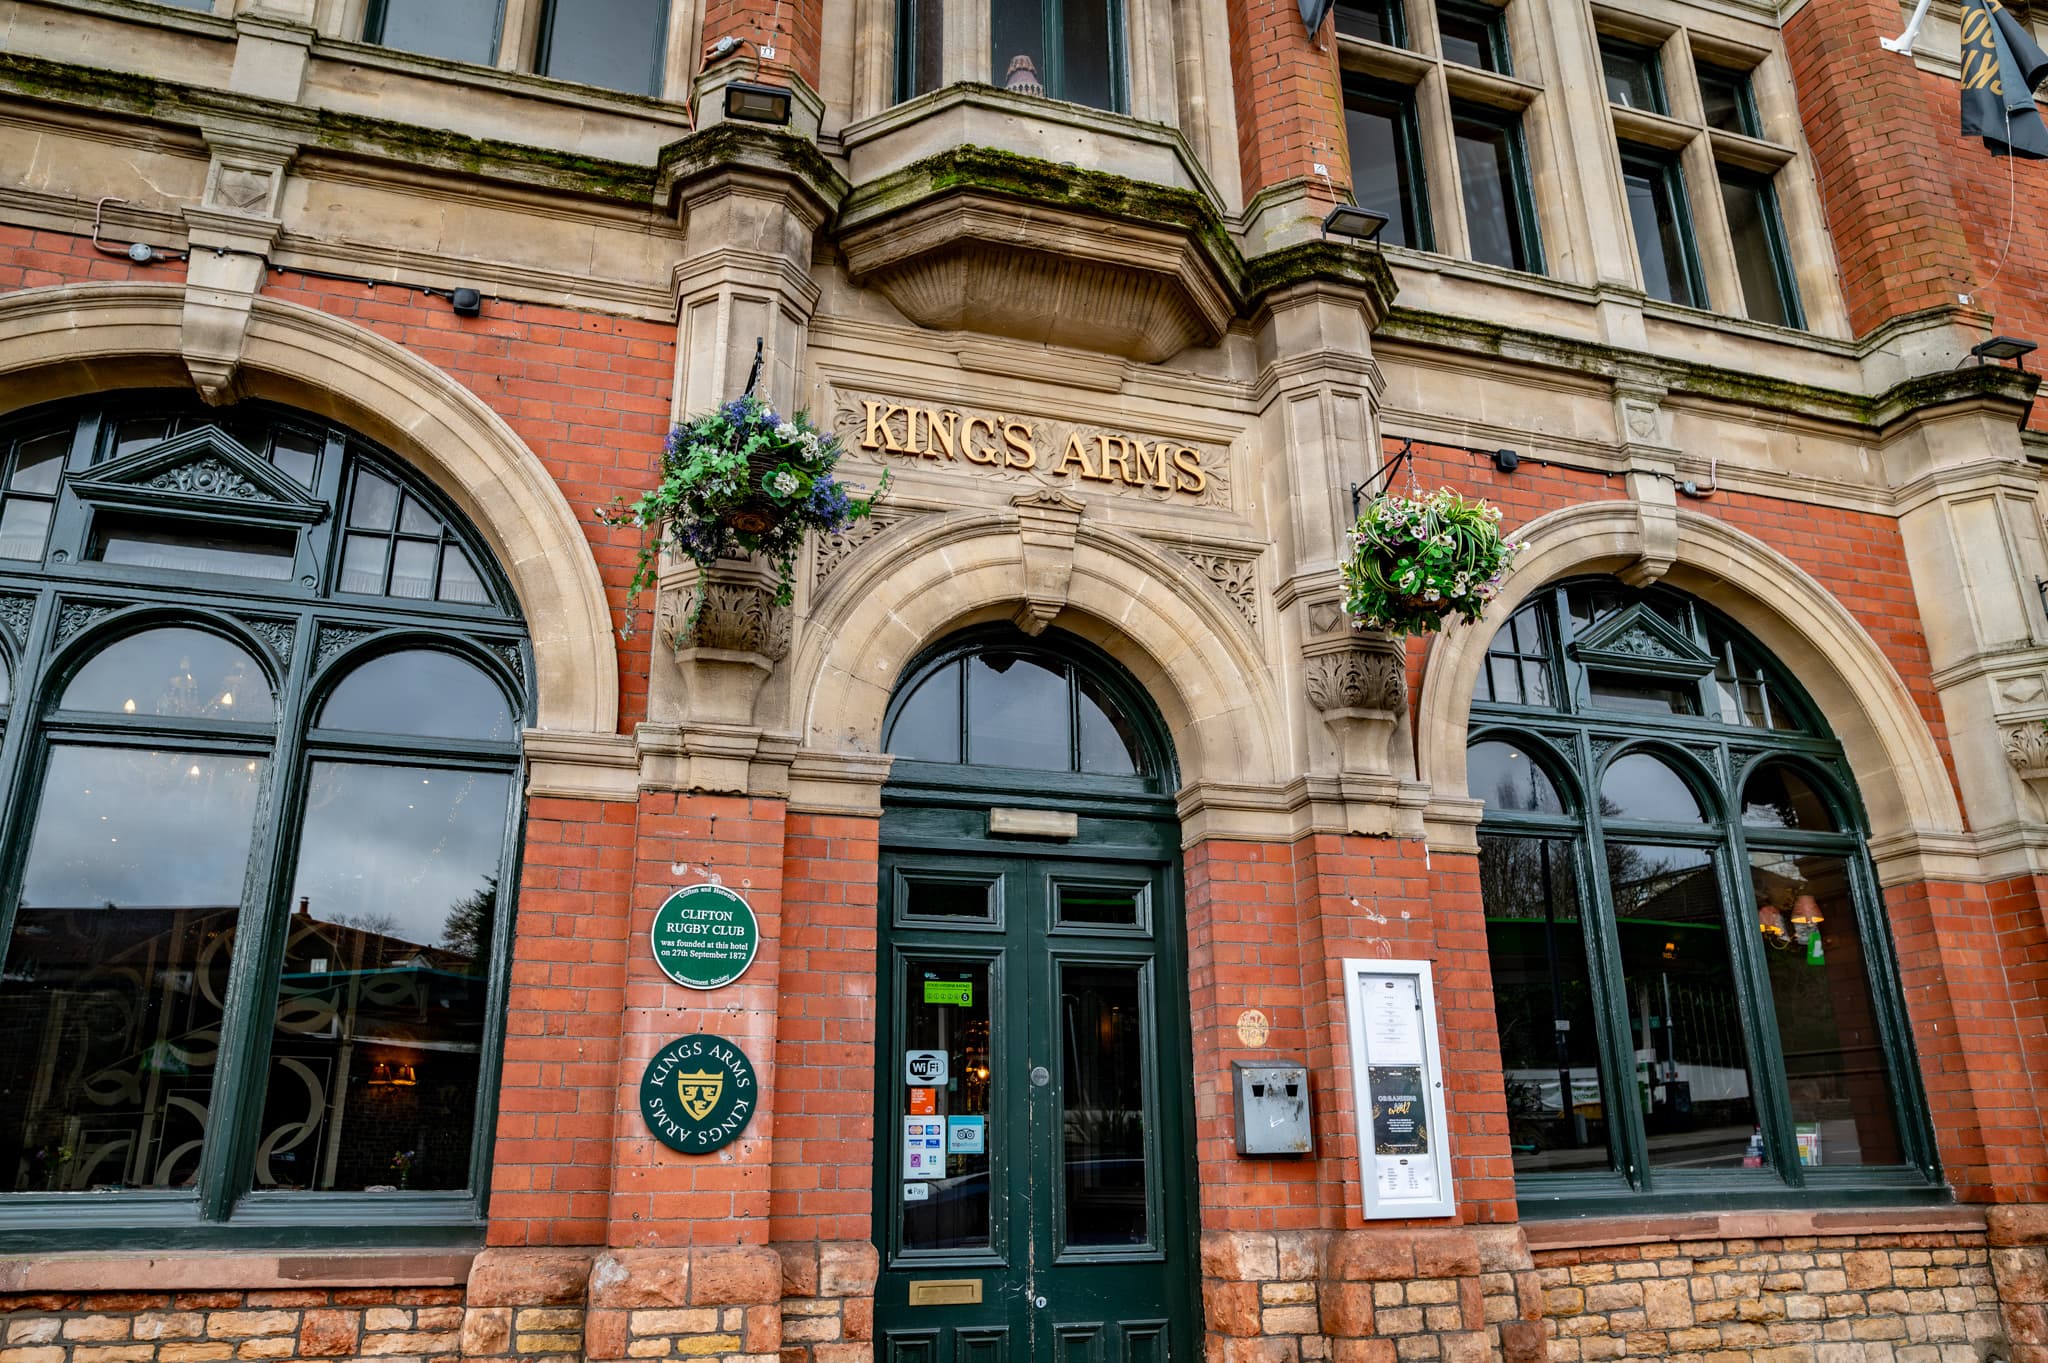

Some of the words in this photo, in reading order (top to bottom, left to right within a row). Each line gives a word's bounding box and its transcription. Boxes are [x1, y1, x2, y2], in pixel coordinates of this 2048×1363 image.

[861, 400, 1037, 470] KING'S
[1053, 431, 1207, 493] ARMS
[666, 922, 711, 934] RUGBY
[712, 925, 745, 936] CLUB
[681, 909, 733, 921] CLIFTON
[672, 949, 688, 957] 27th
[689, 950, 728, 960] September
[729, 951, 747, 960] 1872
[676, 939, 706, 948] founded
[715, 941, 729, 949] this
[730, 942, 748, 950] hotel
[650, 1041, 702, 1088] KINGS
[708, 1044, 750, 1088] ARMS
[649, 1097, 692, 1143] ARMS
[698, 1097, 750, 1145] KINGS
